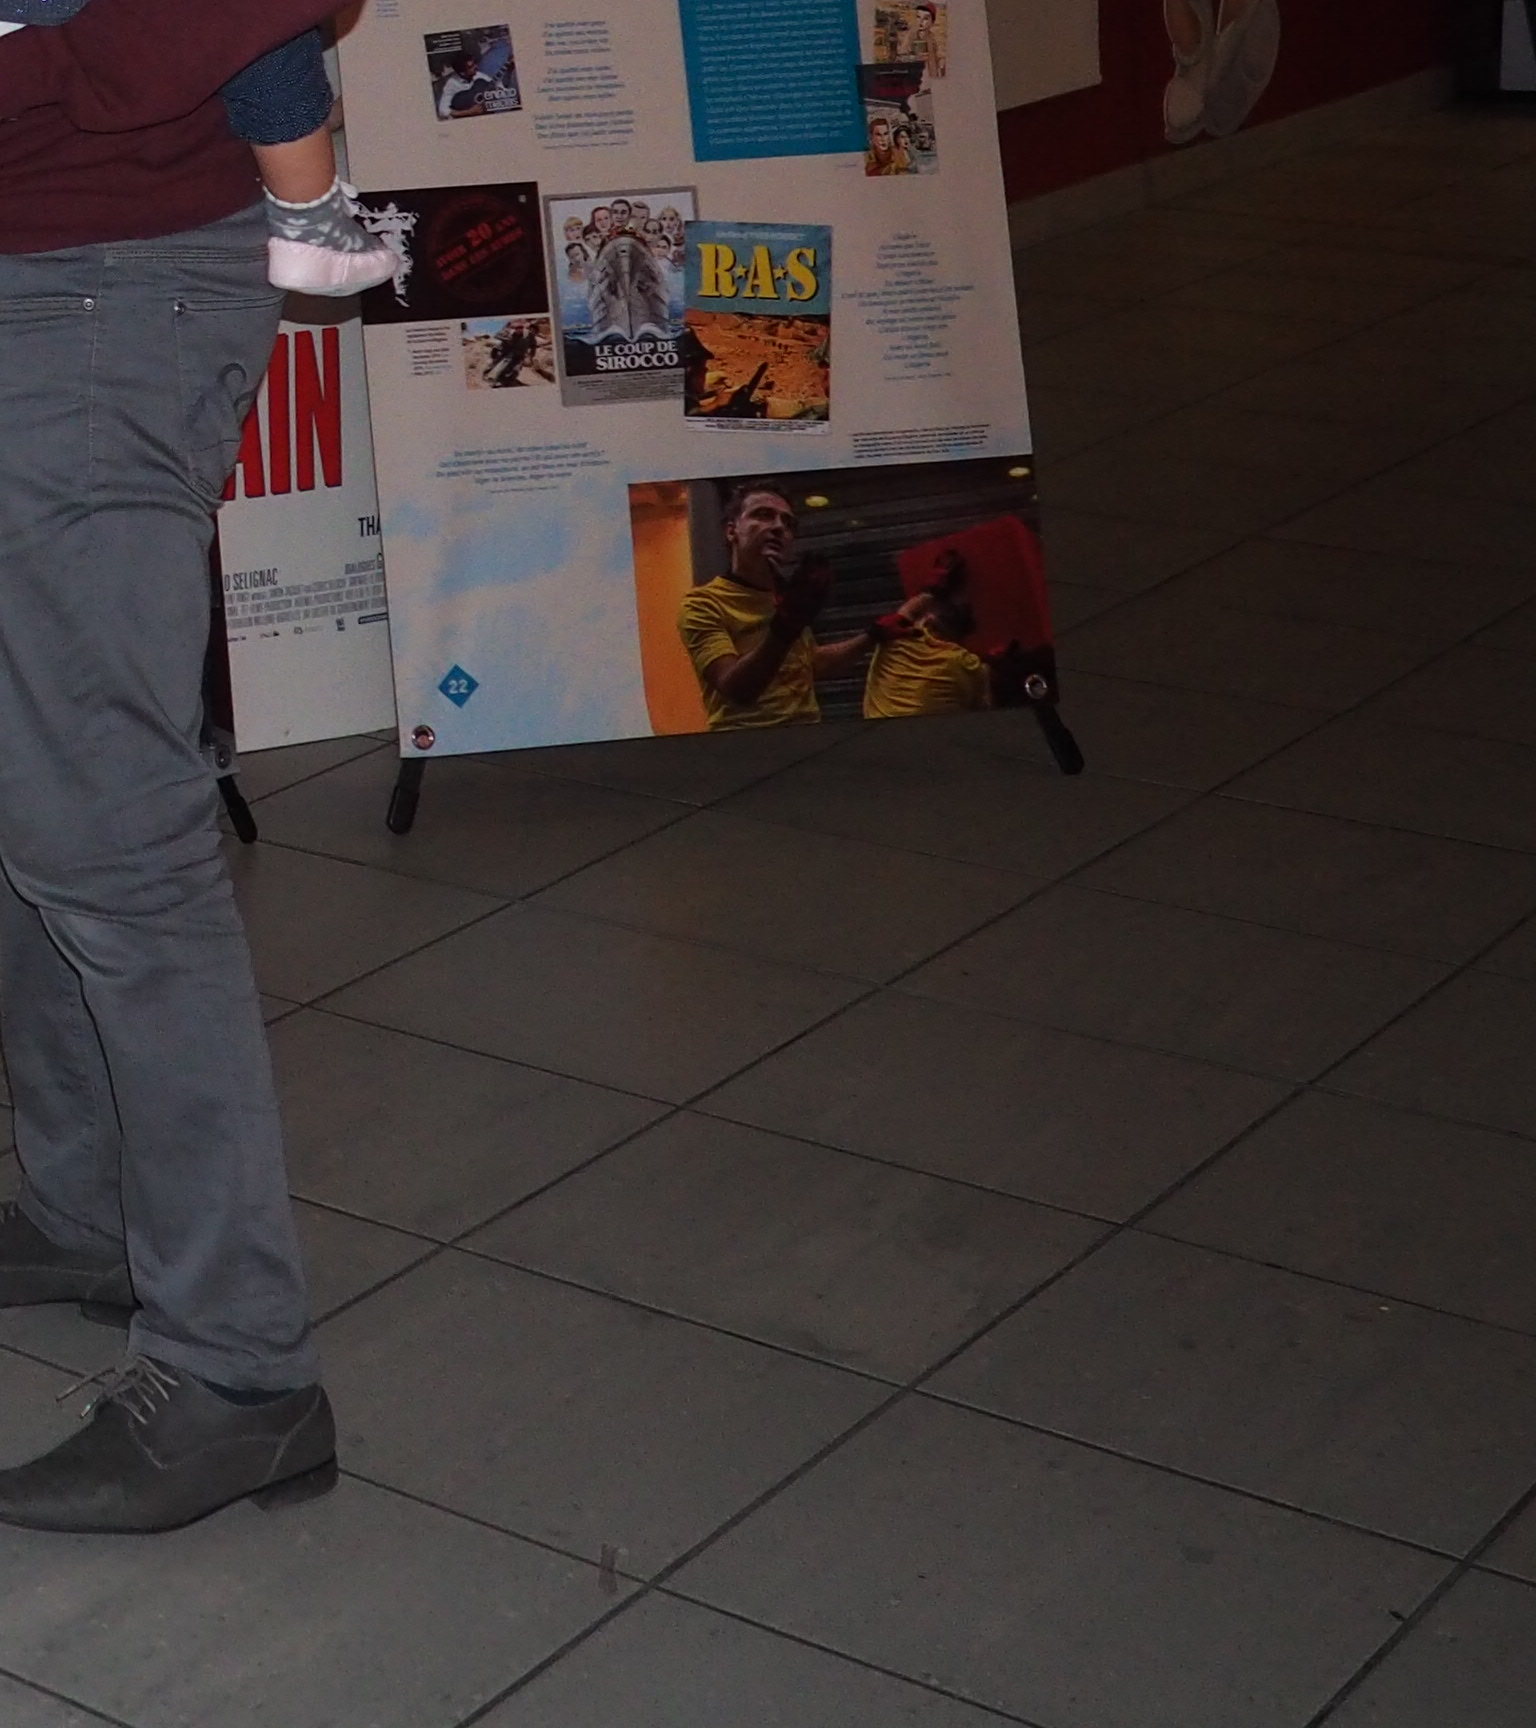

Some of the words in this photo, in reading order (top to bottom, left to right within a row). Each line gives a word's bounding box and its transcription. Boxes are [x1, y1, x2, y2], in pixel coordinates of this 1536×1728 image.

[595, 343, 614, 358] LE
[615, 341, 658, 356] COUP
[660, 341, 678, 353] DE
[596, 351, 680, 371] SIROCCO
[232, 568, 279, 592] SELIGNAC
[448, 678, 468, 695] 22
